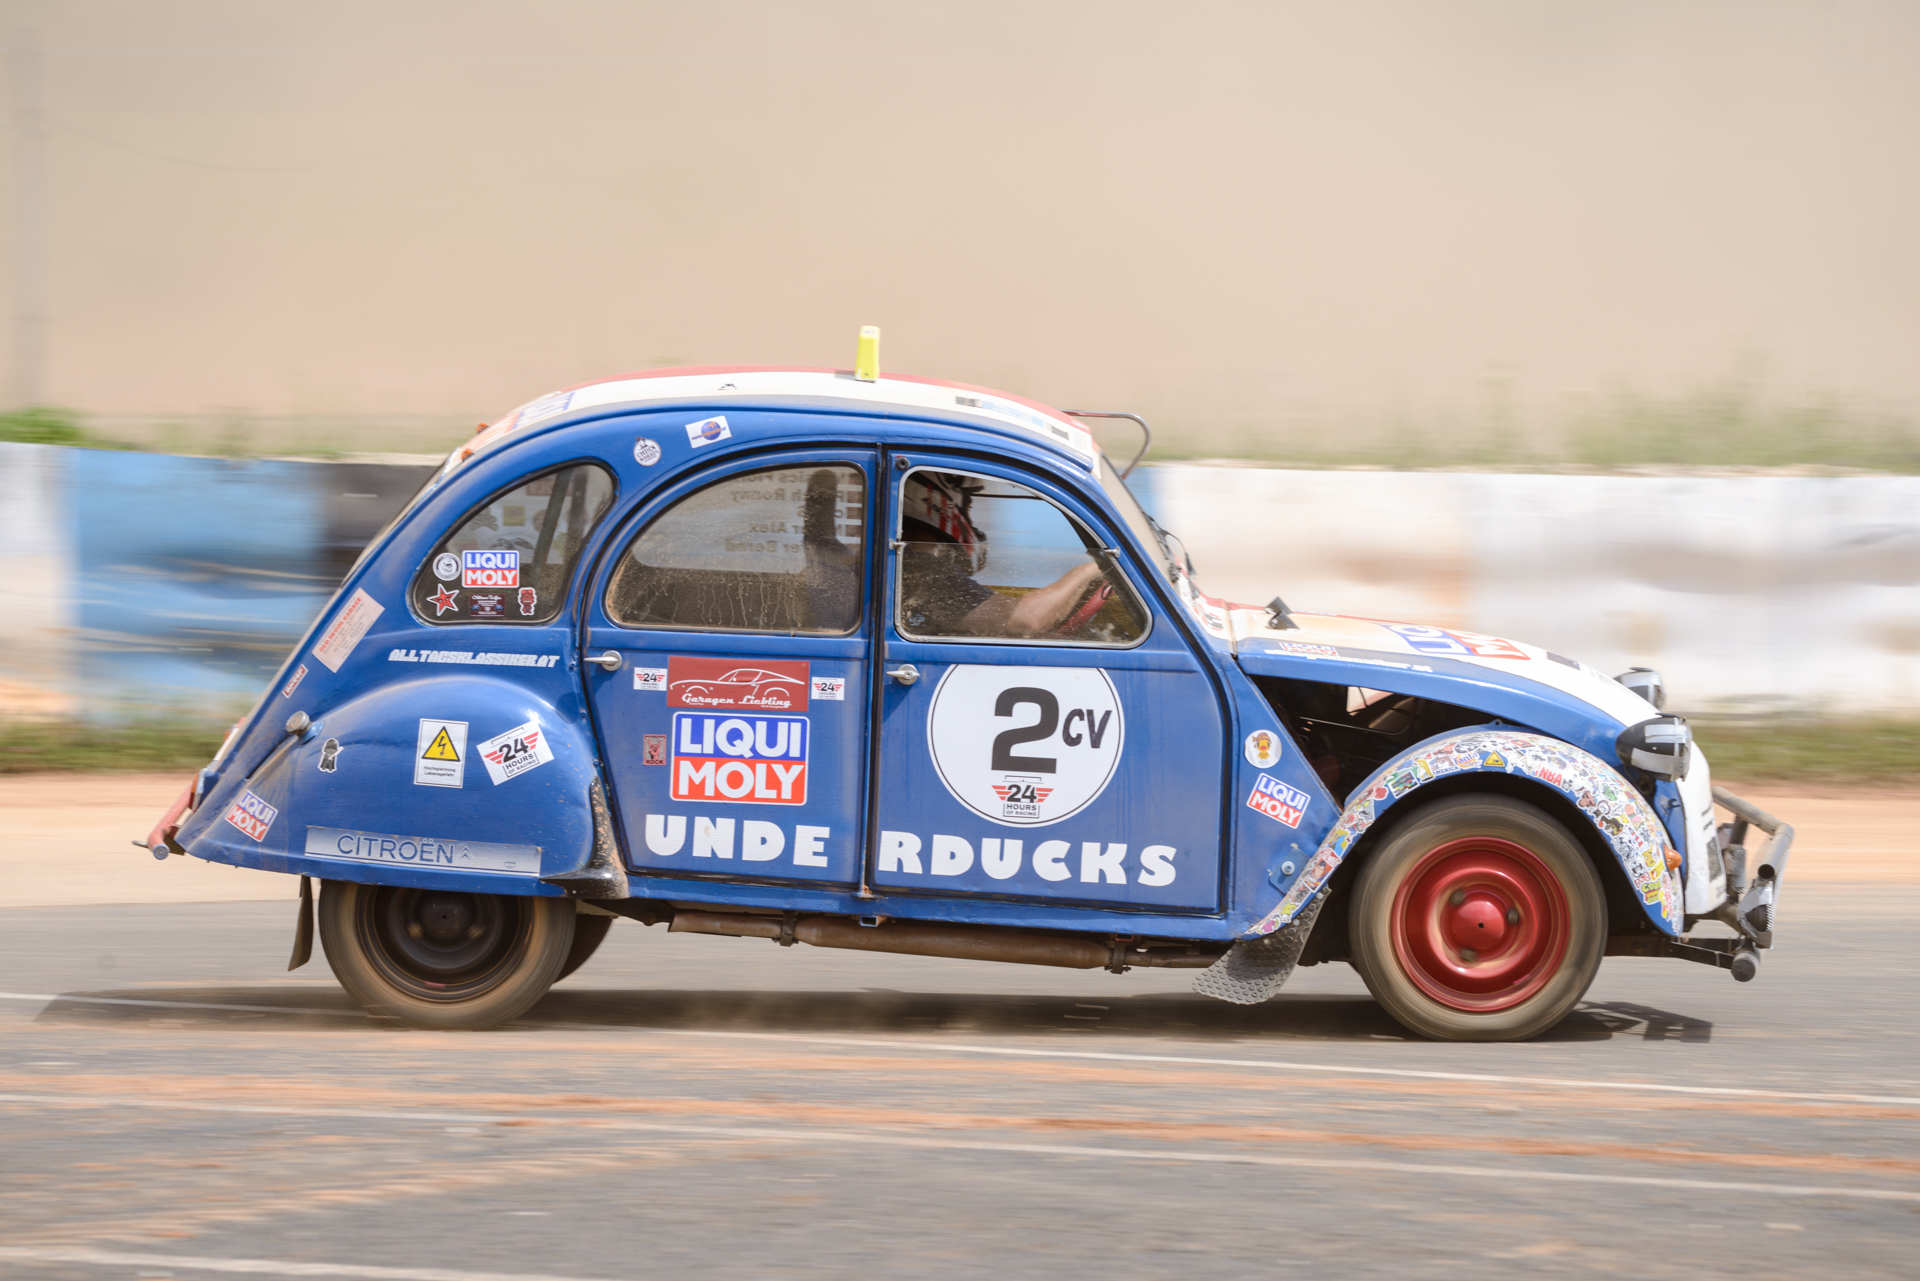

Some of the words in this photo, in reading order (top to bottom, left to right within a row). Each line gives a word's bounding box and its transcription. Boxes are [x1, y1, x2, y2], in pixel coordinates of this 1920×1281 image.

[466, 553, 516, 570] LIQUI
[466, 570, 517, 585] MOLY
[643, 673, 658, 682] 24
[820, 682, 835, 692] 24
[681, 692, 735, 706] Garagen
[737, 695, 793, 708] Liebling
[680, 717, 802, 759] LIQUI
[991, 686, 1060, 774] 2
[1062, 708, 1113, 749] CV
[498, 737, 530, 763] 24
[505, 753, 534, 770] HOURS
[678, 762, 806, 801] MOLY
[1539, 766, 1563, 788] NBA
[1006, 784, 1038, 803] 24
[1257, 776, 1307, 810] LIQUI
[1006, 803, 1037, 811] HOURS
[1250, 792, 1301, 825] MOLY
[227, 804, 269, 838] MOLY
[337, 834, 455, 864] CITROËN
[645, 814, 831, 868] UNDE
[878, 830, 1178, 887] RDUCKS
